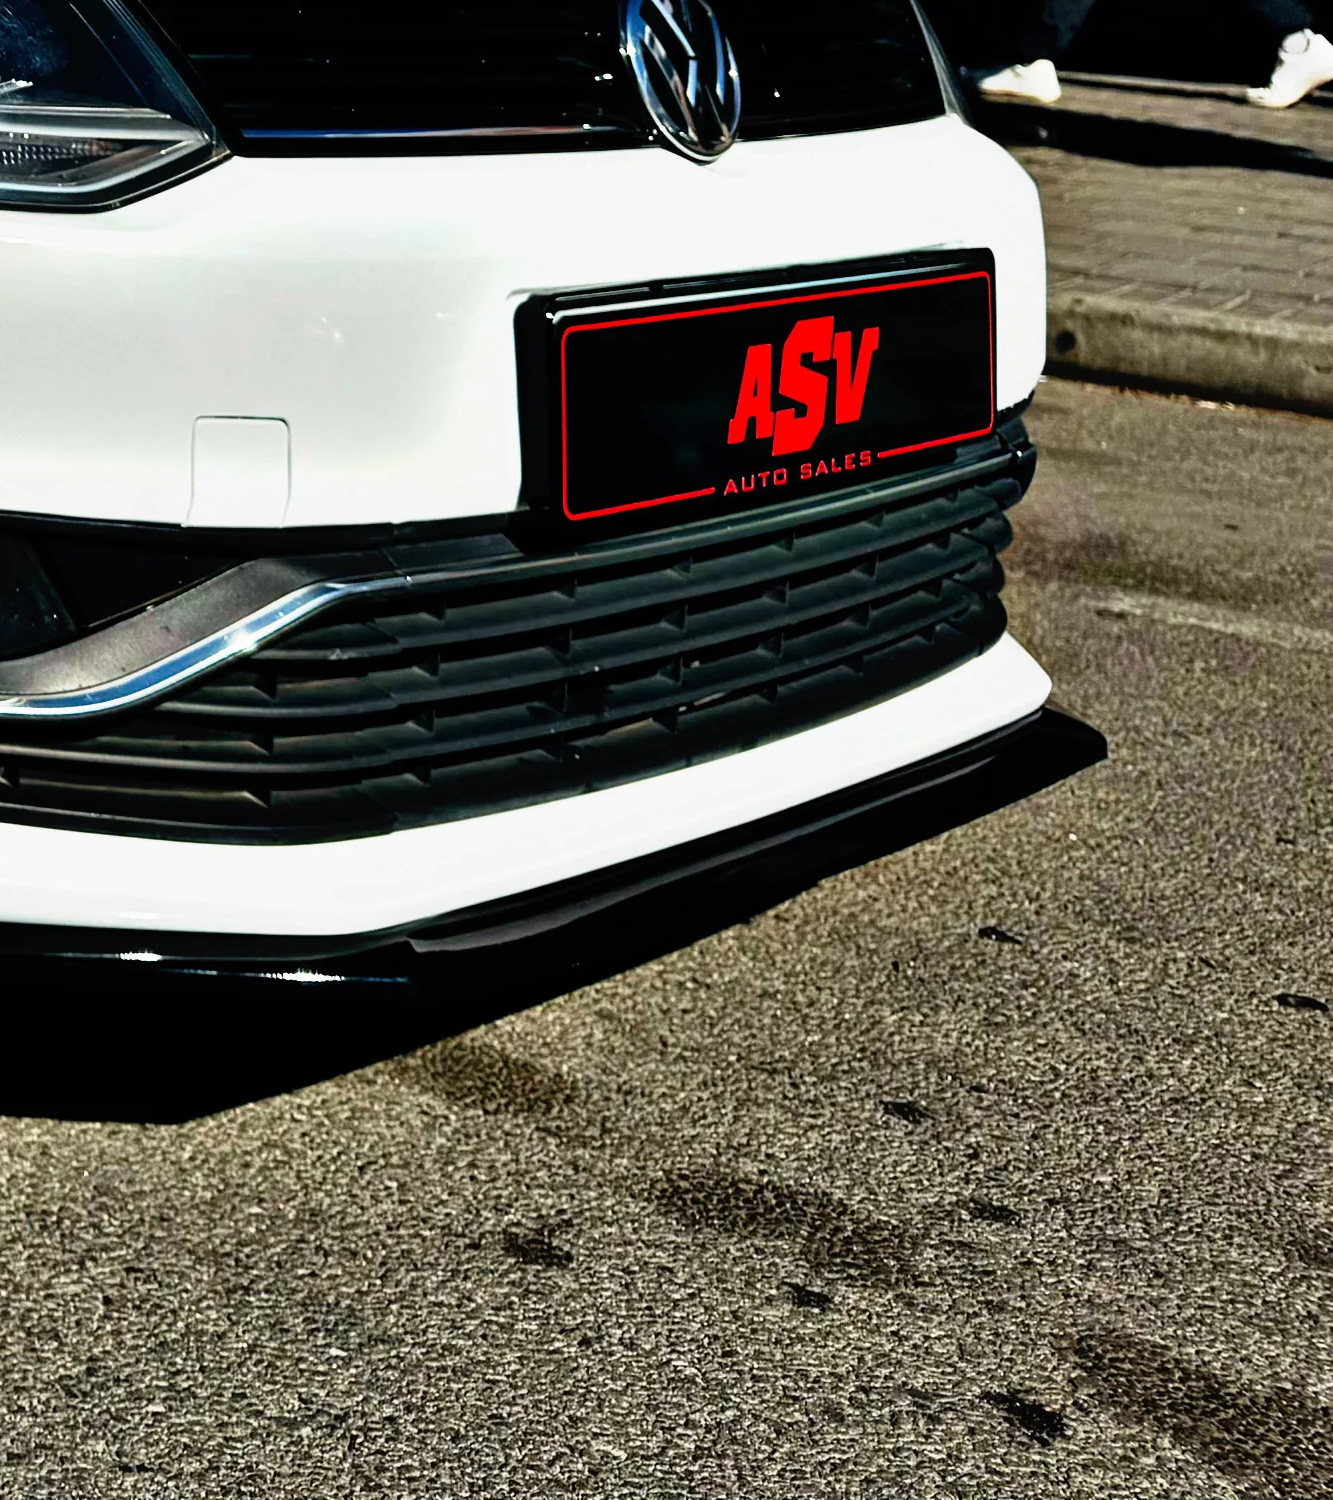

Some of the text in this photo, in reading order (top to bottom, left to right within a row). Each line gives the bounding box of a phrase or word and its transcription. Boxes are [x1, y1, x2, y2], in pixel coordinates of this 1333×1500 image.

[727, 315, 880, 457] ASV
[723, 450, 872, 497] AUTO SALES
